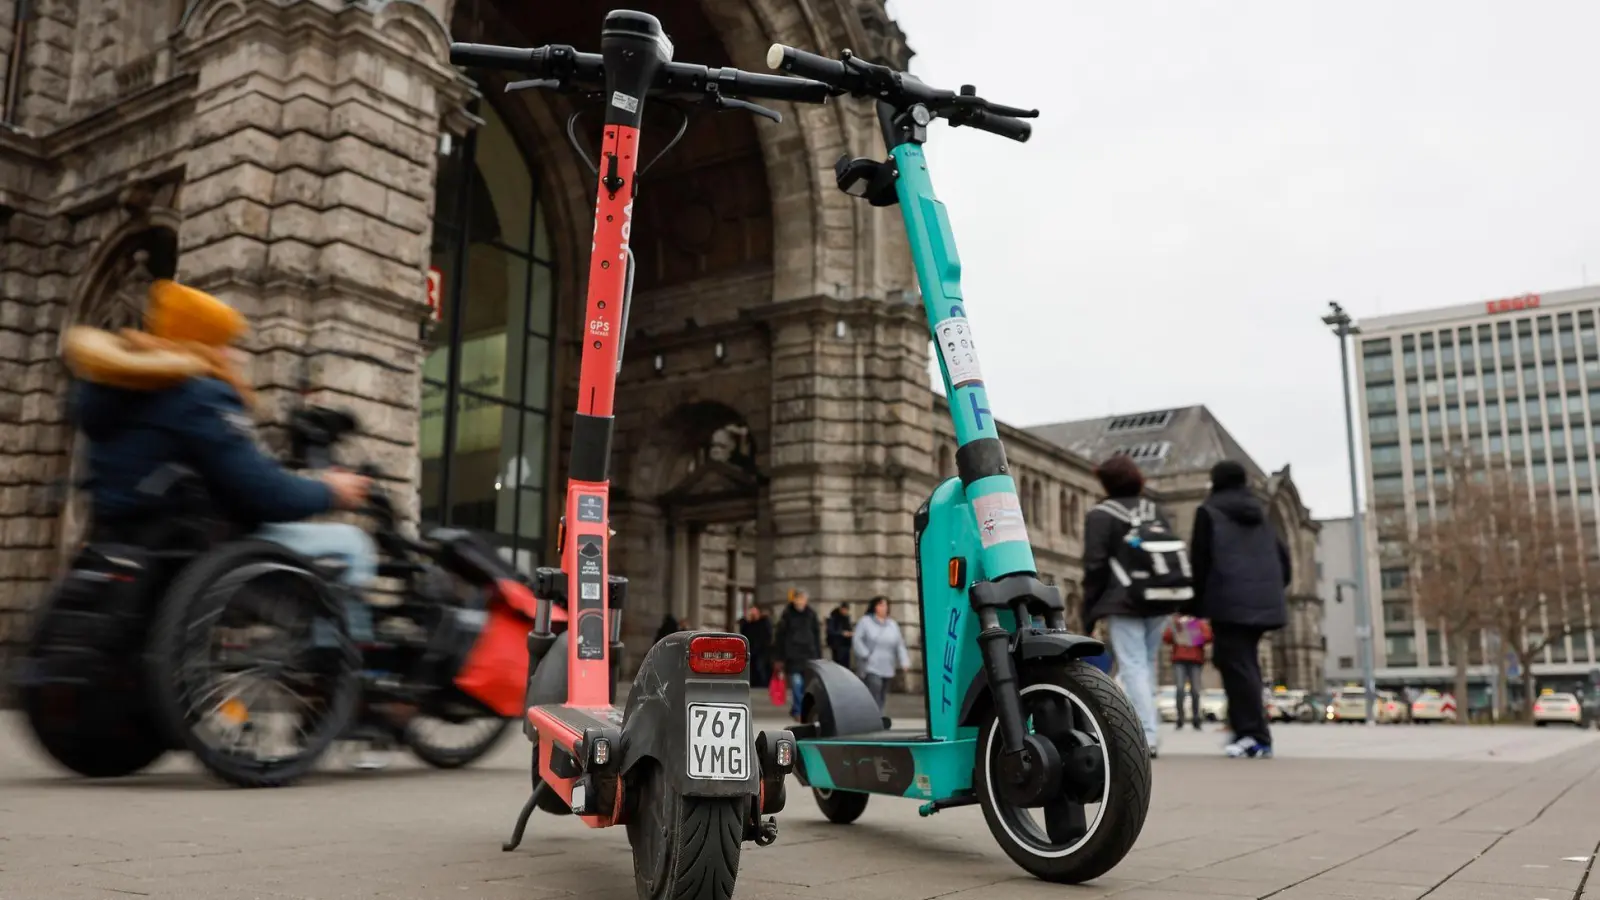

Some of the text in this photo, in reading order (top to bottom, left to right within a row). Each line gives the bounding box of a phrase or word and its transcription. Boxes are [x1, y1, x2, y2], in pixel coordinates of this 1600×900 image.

[590, 319, 610, 332] GPS
[942, 607, 962, 715] TIER
[695, 709, 742, 740] 767
[693, 744, 742, 775] YMG
